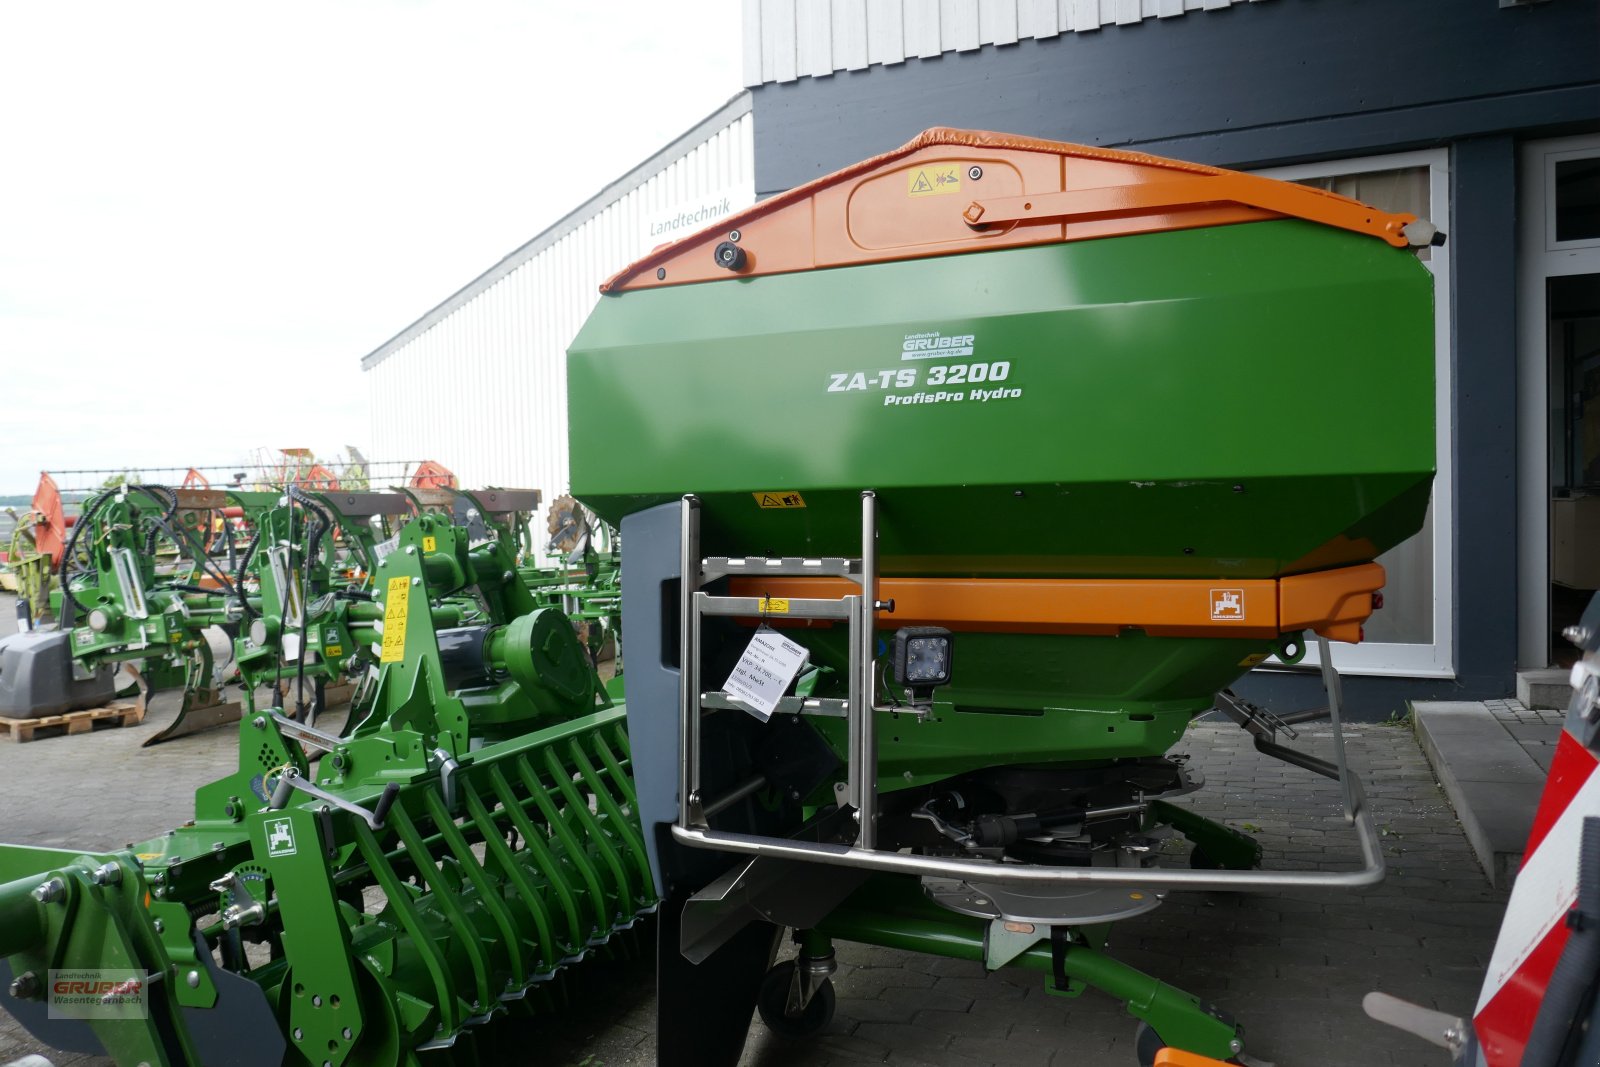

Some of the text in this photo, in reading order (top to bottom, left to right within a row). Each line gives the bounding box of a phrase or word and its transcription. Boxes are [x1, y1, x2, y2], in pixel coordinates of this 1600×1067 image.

[650, 197, 731, 237] Landtechnik
[902, 335, 975, 351] GRUBER
[904, 331, 940, 340] Landtechnik
[827, 361, 1010, 393] ZA-TS 3200
[884, 387, 1022, 406] ProfisPro Hydro
